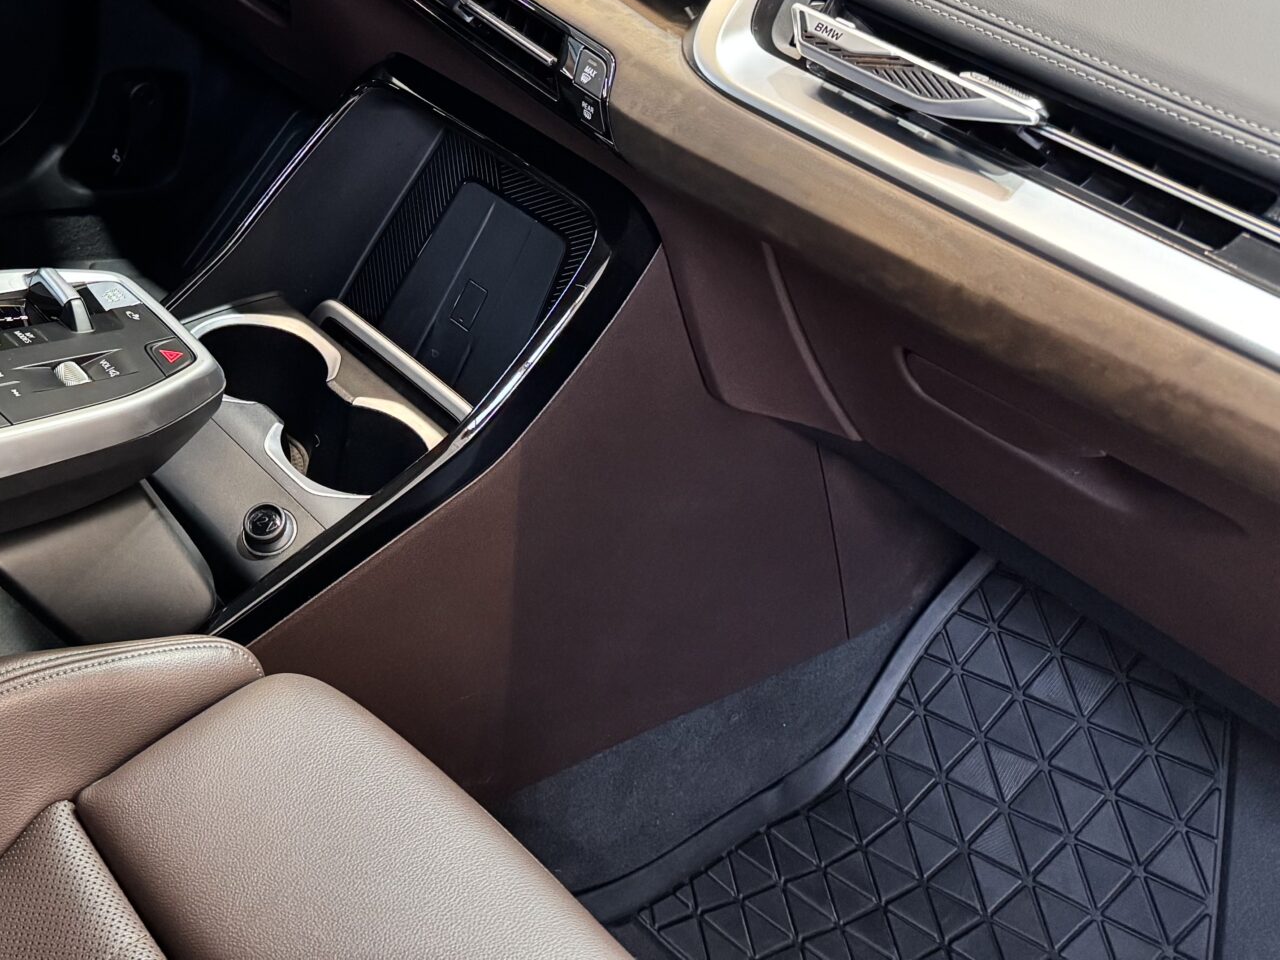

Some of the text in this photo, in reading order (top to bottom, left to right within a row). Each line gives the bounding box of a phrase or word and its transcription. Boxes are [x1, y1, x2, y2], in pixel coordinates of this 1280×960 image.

[814, 23, 843, 41] BMW
[583, 65, 598, 78] MAX
[581, 100, 595, 115] REAR
[14, 330, 32, 344] MODES
[100, 359, 111, 370] VOL
